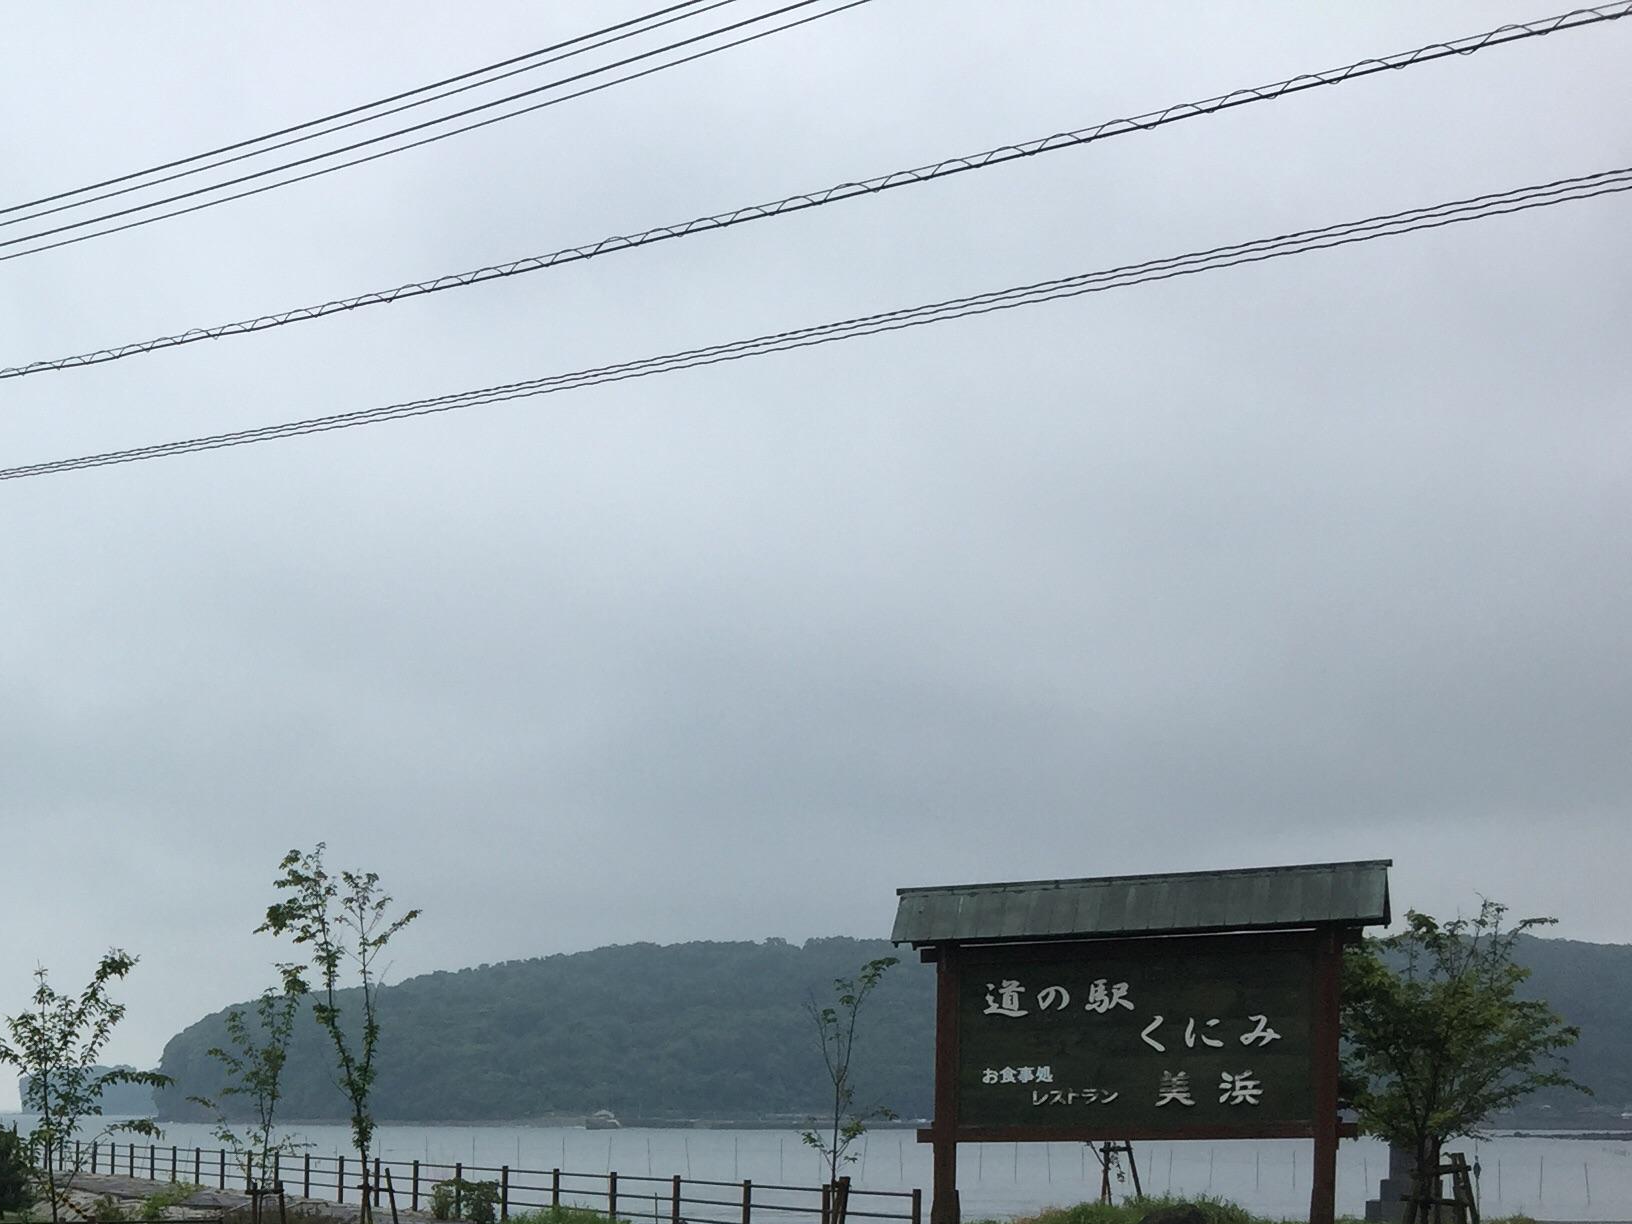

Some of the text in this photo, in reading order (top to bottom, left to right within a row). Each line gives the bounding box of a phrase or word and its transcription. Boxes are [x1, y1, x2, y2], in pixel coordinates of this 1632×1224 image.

[983, 979, 1135, 1018] 道の駅
[1140, 1015, 1282, 1052] くにみ
[982, 1066, 1054, 1085] お食事処
[1155, 1070, 1264, 1107] 美浜
[1032, 1088, 1119, 1106] レストラン
